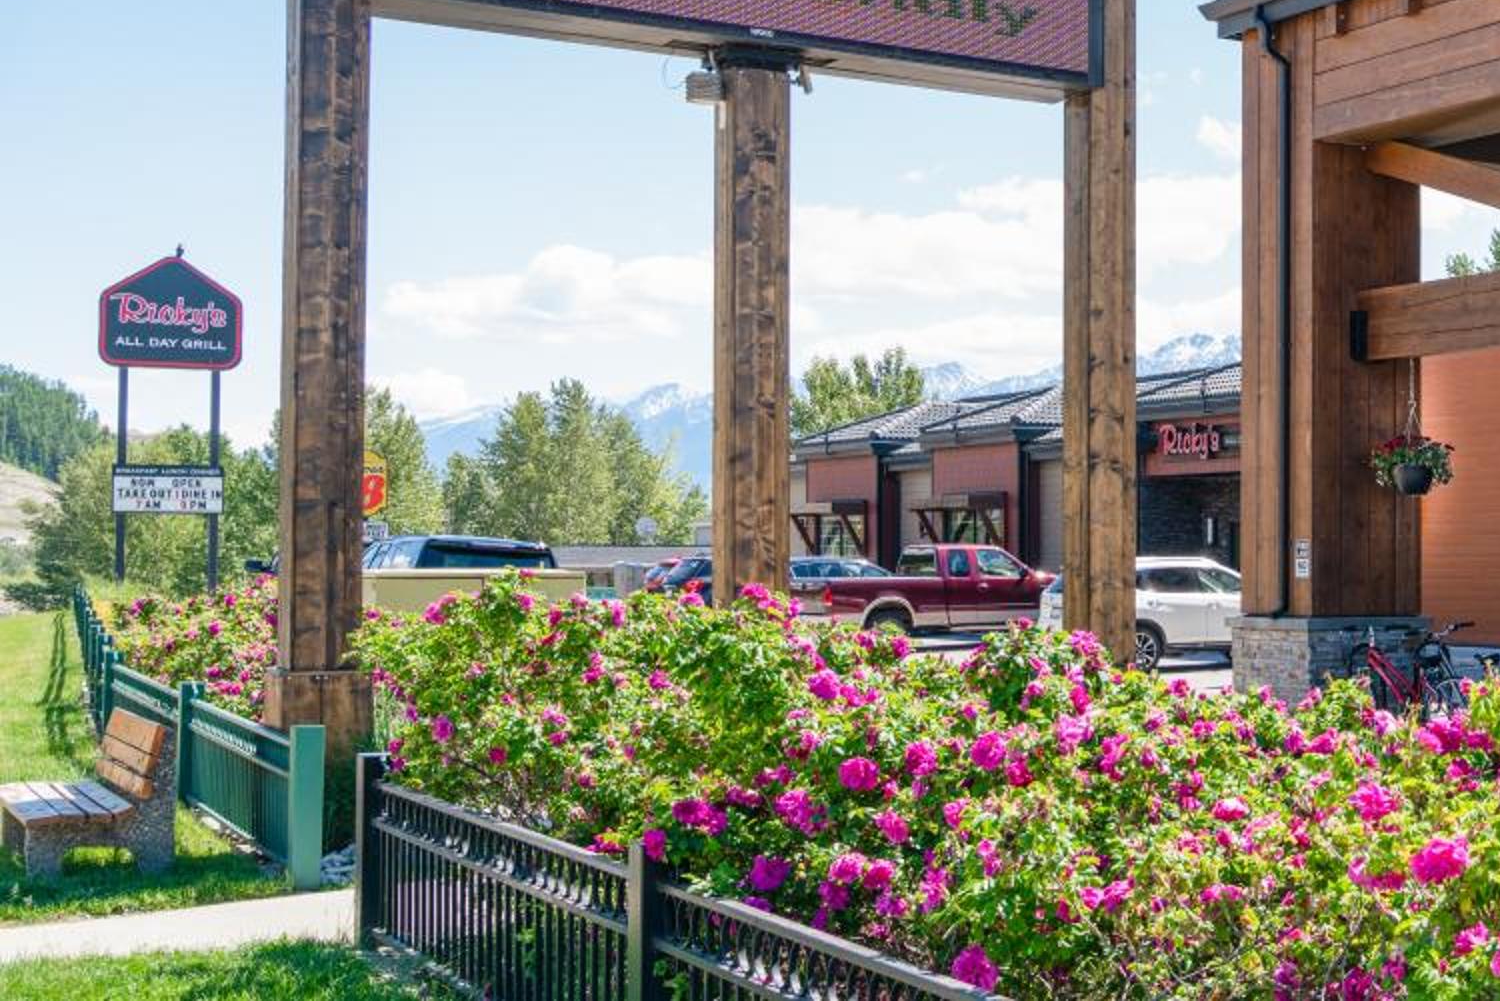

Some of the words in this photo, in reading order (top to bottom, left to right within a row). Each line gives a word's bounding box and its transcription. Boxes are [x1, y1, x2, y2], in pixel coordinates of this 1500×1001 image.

[110, 293, 227, 334] Ricky's
[115, 336, 144, 346] ALL
[149, 338, 178, 348] DAY
[182, 339, 227, 350] GRILL
[1159, 423, 1220, 459] Ricky's
